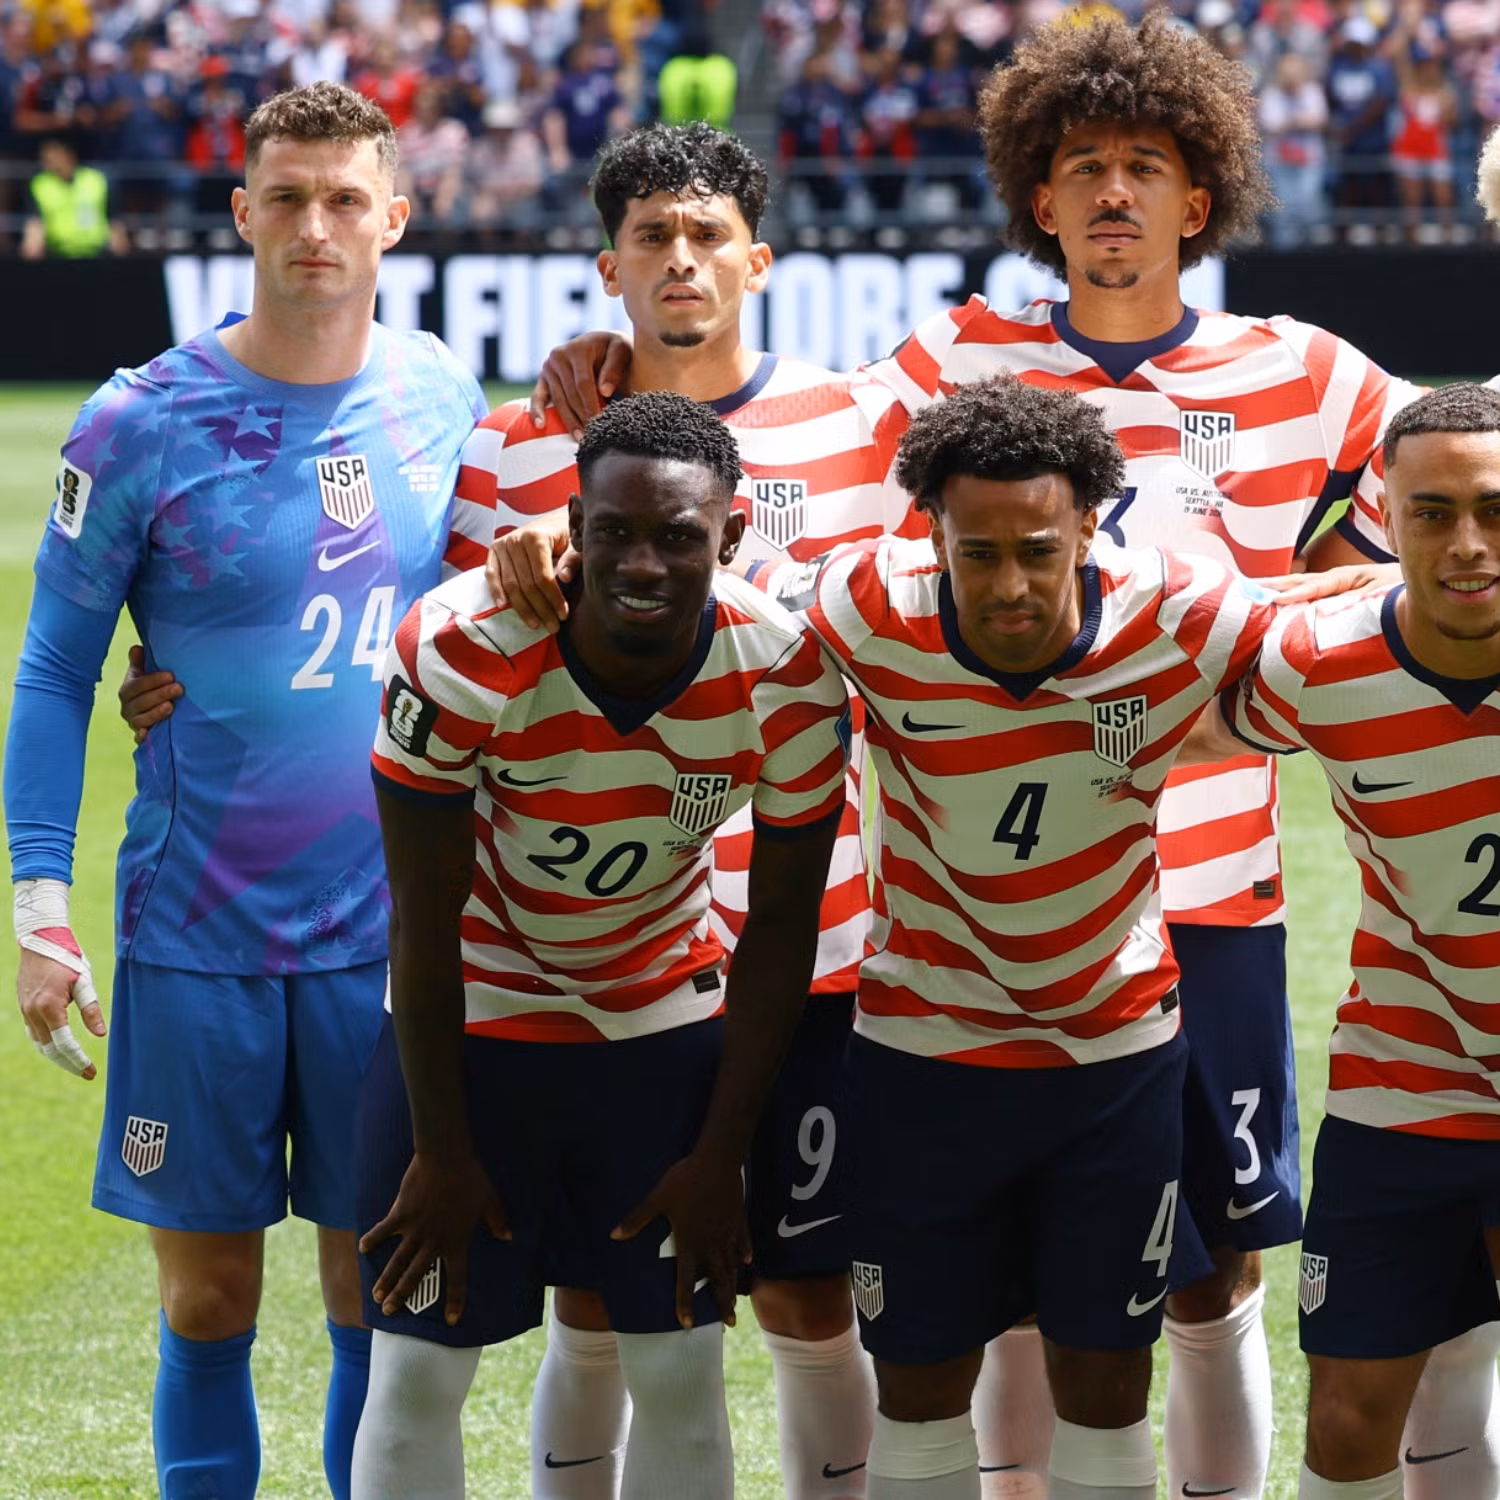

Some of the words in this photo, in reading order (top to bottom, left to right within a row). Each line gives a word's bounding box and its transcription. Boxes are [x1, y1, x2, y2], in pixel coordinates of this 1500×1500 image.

[1183, 413, 1232, 441] USA
[320, 457, 366, 489] USA
[755, 480, 804, 510] USA
[290, 585, 396, 690] 24
[1098, 699, 1145, 729] USA
[677, 775, 728, 801] USA
[992, 781, 1049, 862] 4
[526, 825, 648, 898] 20
[127, 1118, 167, 1145] USA
[1231, 1087, 1262, 1186] 3
[790, 1105, 837, 1202] 9
[1141, 1179, 1179, 1278] 4
[853, 1262, 881, 1288] USA
